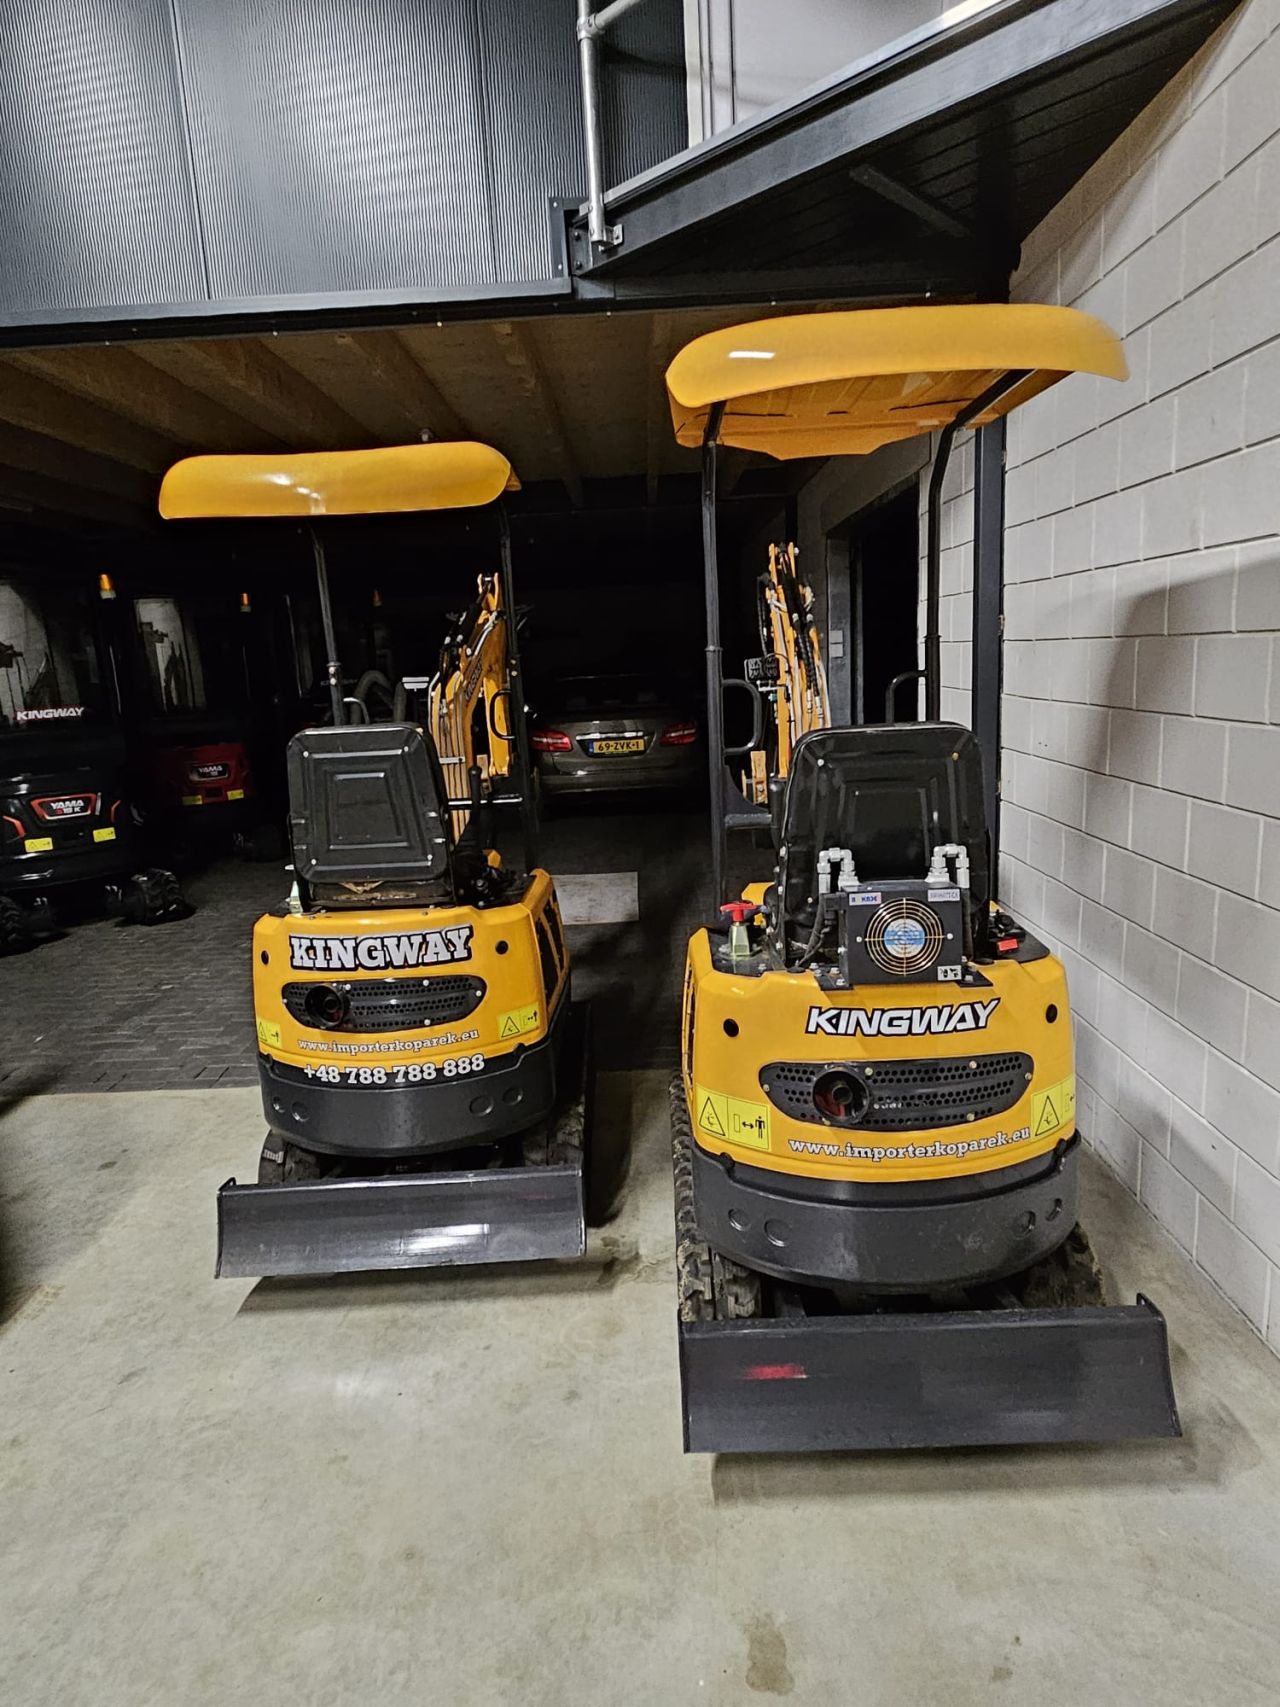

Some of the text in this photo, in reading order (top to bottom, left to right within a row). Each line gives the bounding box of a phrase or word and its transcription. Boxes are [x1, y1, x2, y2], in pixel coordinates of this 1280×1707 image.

[16, 706, 85, 721] KINGWAY
[598, 741, 640, 751] 69-ZVK-1
[50, 799, 84, 810] YAMA
[290, 926, 472, 969] KINGWAY
[806, 998, 1000, 1035] KINGWAY
[297, 1028, 479, 1056] www.importerkoparek.eu
[303, 1053, 486, 1085] +48 788 788 888
[788, 1127, 1031, 1162] www.importerkoparek.eu
